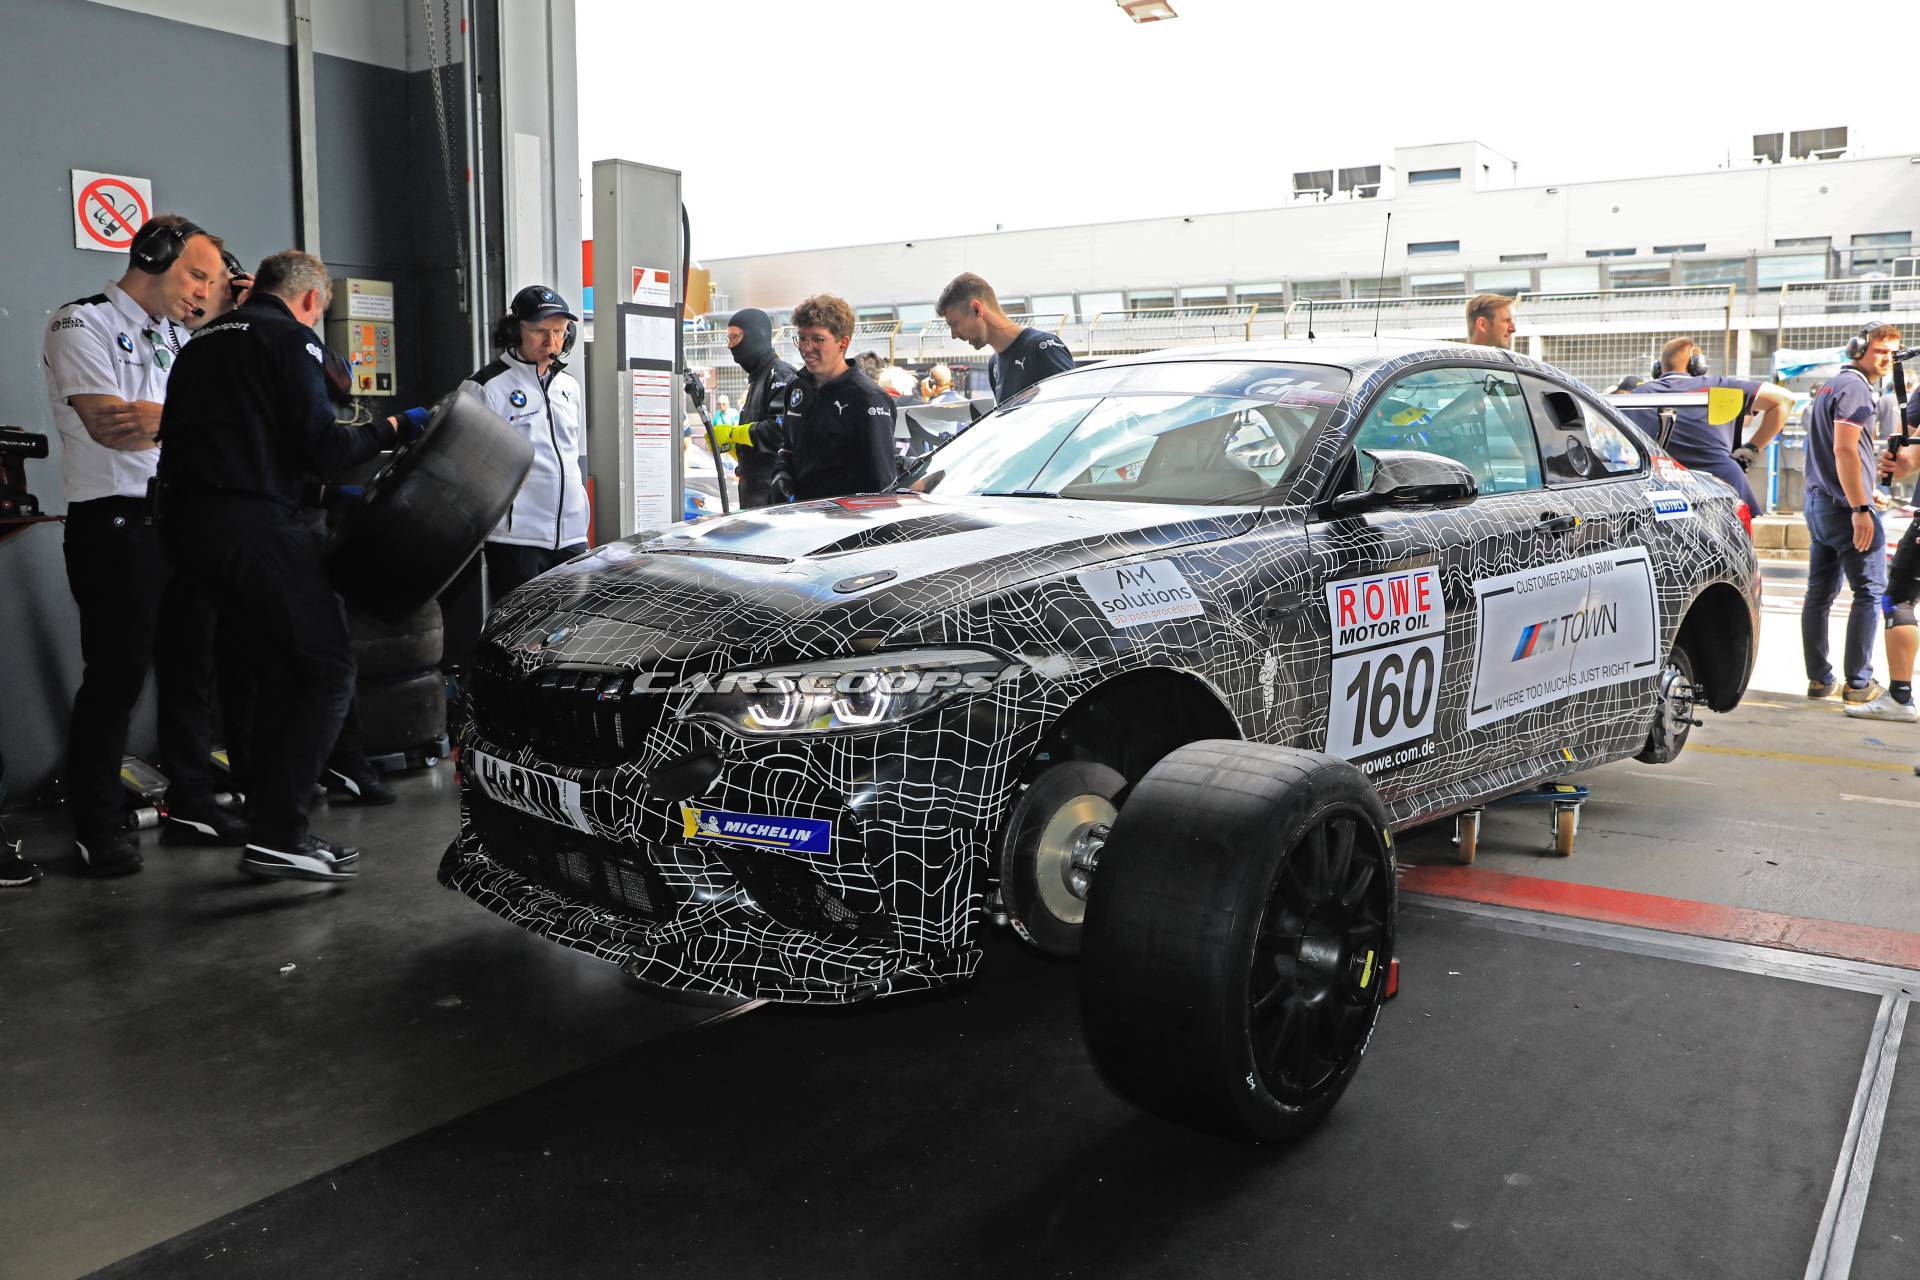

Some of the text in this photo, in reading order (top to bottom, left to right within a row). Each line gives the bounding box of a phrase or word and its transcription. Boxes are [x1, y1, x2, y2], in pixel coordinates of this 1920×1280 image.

[1116, 565, 1156, 590] AM
[1516, 559, 1614, 594] CUSTOMER RACING IN BMW
[1101, 586, 1193, 613] solutions
[1112, 614, 1128, 625] 3D
[1151, 602, 1200, 619] processing
[1336, 572, 1431, 627] ROWE
[1339, 613, 1430, 646] MOTOR OIL
[1560, 602, 1617, 647] TOWN
[1346, 645, 1435, 747] 160
[1494, 661, 1631, 711] WHERE TOO MUCH IS JUST RIGHT
[723, 821, 812, 842] MICHELIN
